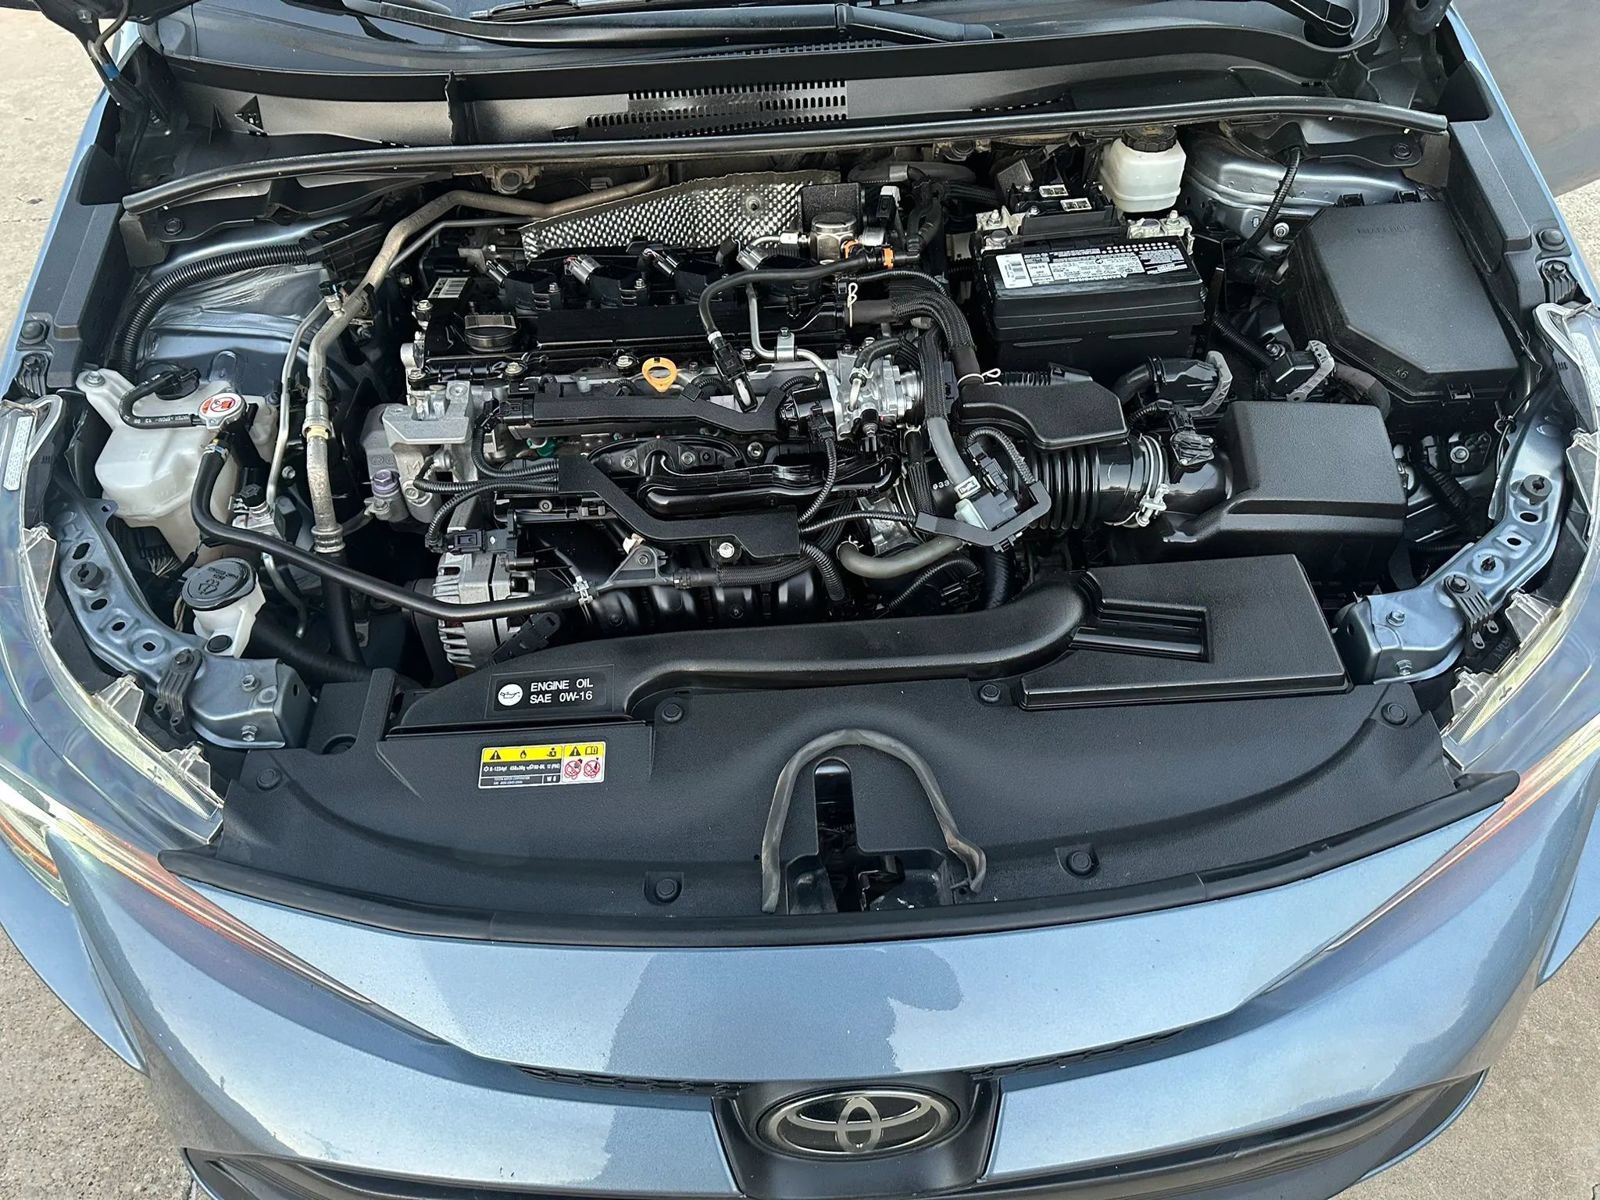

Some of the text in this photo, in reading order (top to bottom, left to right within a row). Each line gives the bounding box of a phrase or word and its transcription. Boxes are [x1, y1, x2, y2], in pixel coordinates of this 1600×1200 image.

[530, 678, 593, 692] ENGINE OIL
[530, 691, 593, 704] SAE 0W-16
